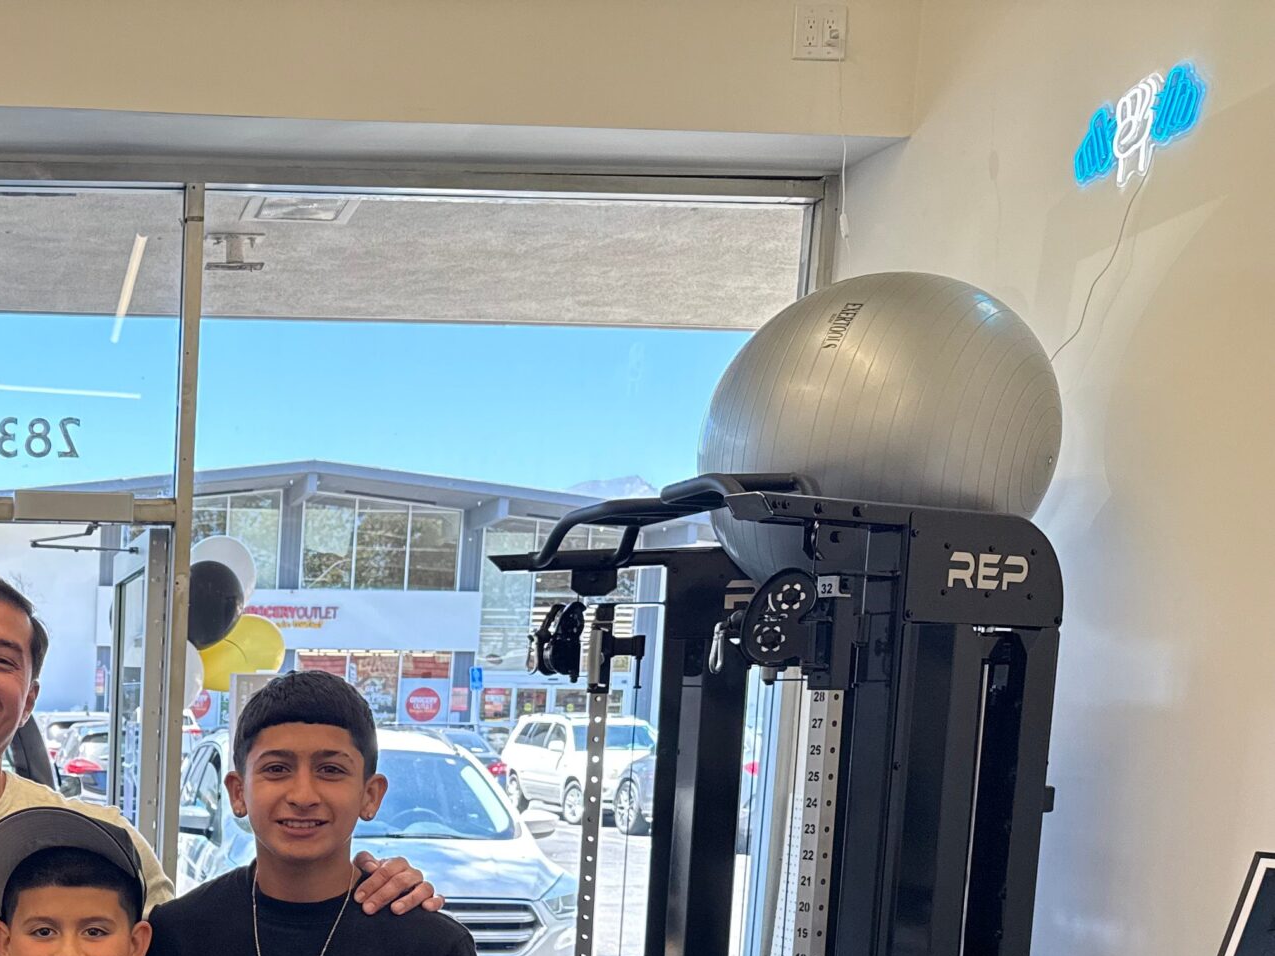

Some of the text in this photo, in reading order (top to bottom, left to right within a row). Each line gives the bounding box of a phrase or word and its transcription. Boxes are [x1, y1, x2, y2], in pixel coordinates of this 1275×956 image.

[822, 303, 864, 348] EXERTOOLS
[947, 551, 1029, 591] REP
[821, 583, 833, 594] 32
[813, 692, 825, 702] 28
[812, 718, 823, 729] 27
[808, 772, 819, 782] 25
[806, 798, 817, 808] 24
[804, 824, 816, 834] 23
[803, 850, 814, 860] 22
[801, 876, 811, 886] 21
[799, 902, 810, 912] 20
